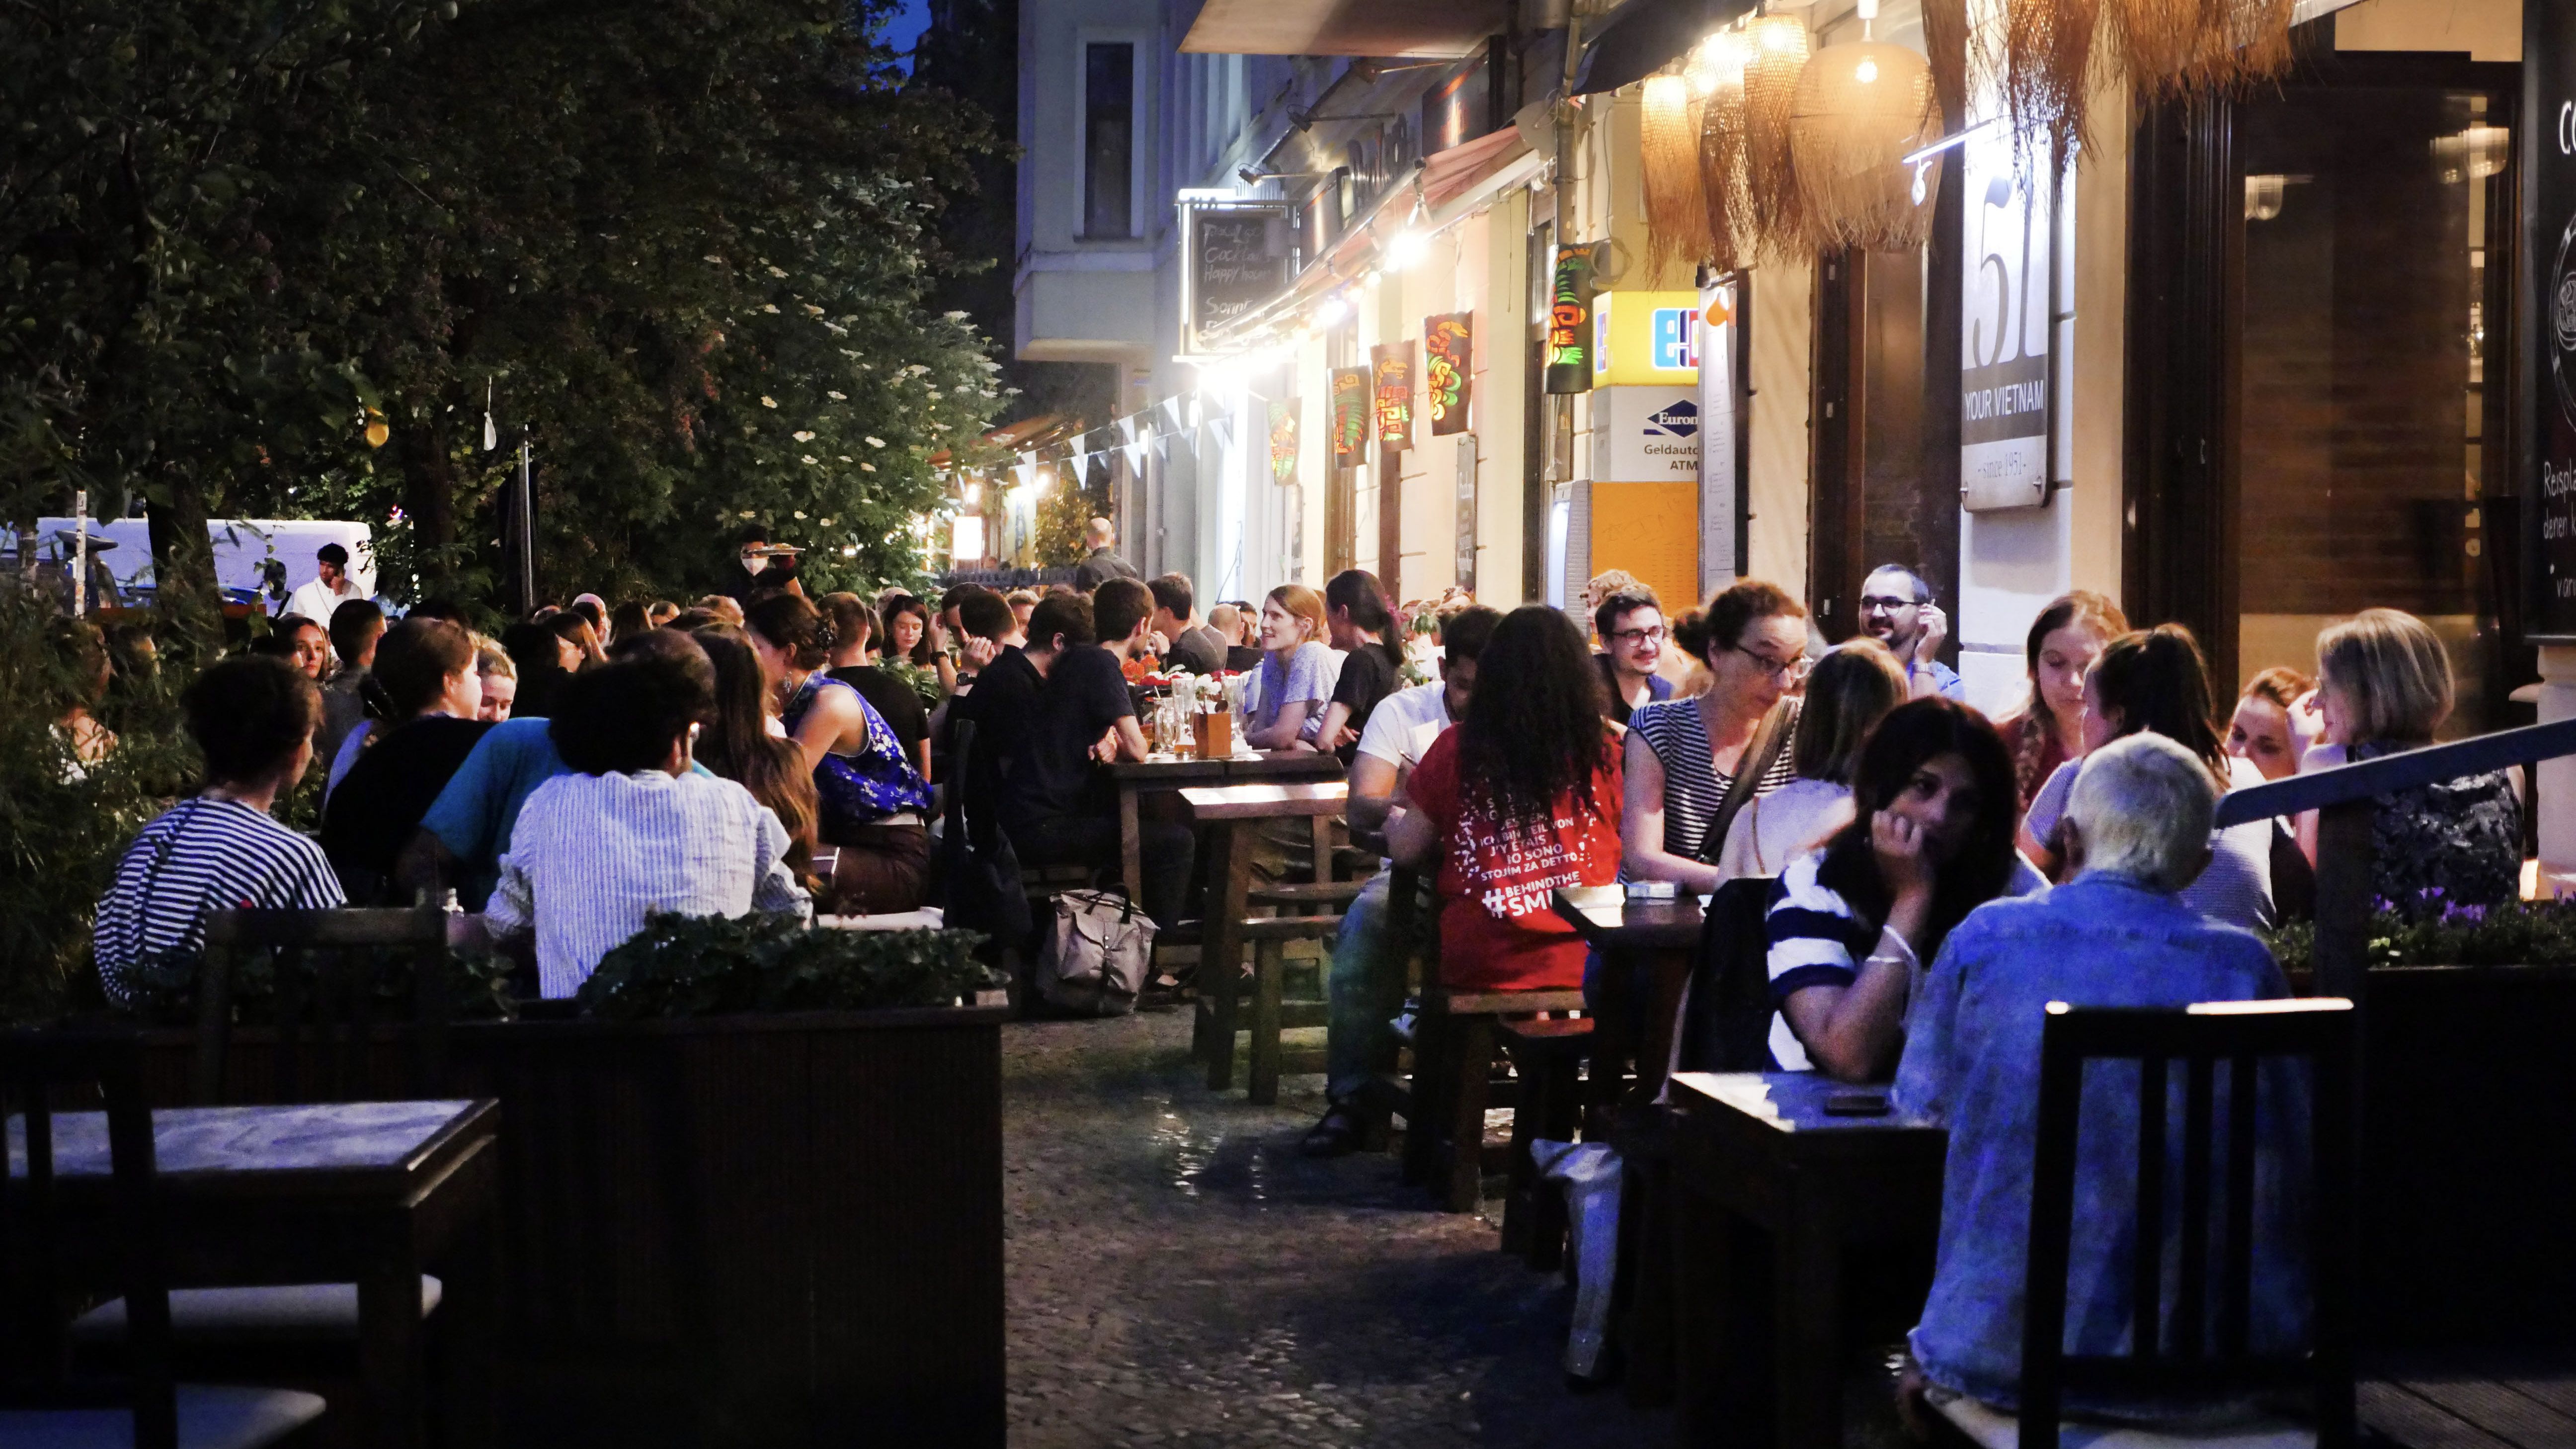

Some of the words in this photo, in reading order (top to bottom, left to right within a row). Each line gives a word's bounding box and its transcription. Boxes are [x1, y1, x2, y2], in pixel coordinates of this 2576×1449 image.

[2560, 100, 2576, 155] C
[1204, 263, 1239, 284] Happy
[1965, 389, 1992, 421] YOUR
[1994, 379, 2044, 417] VIETNAM
[1670, 460, 1698, 470] ATM
[2543, 507, 2568, 539] denen
[1524, 843, 1563, 861] SONO
[1524, 860, 1539, 872] ZA
[1541, 852, 1578, 868] DETTO
